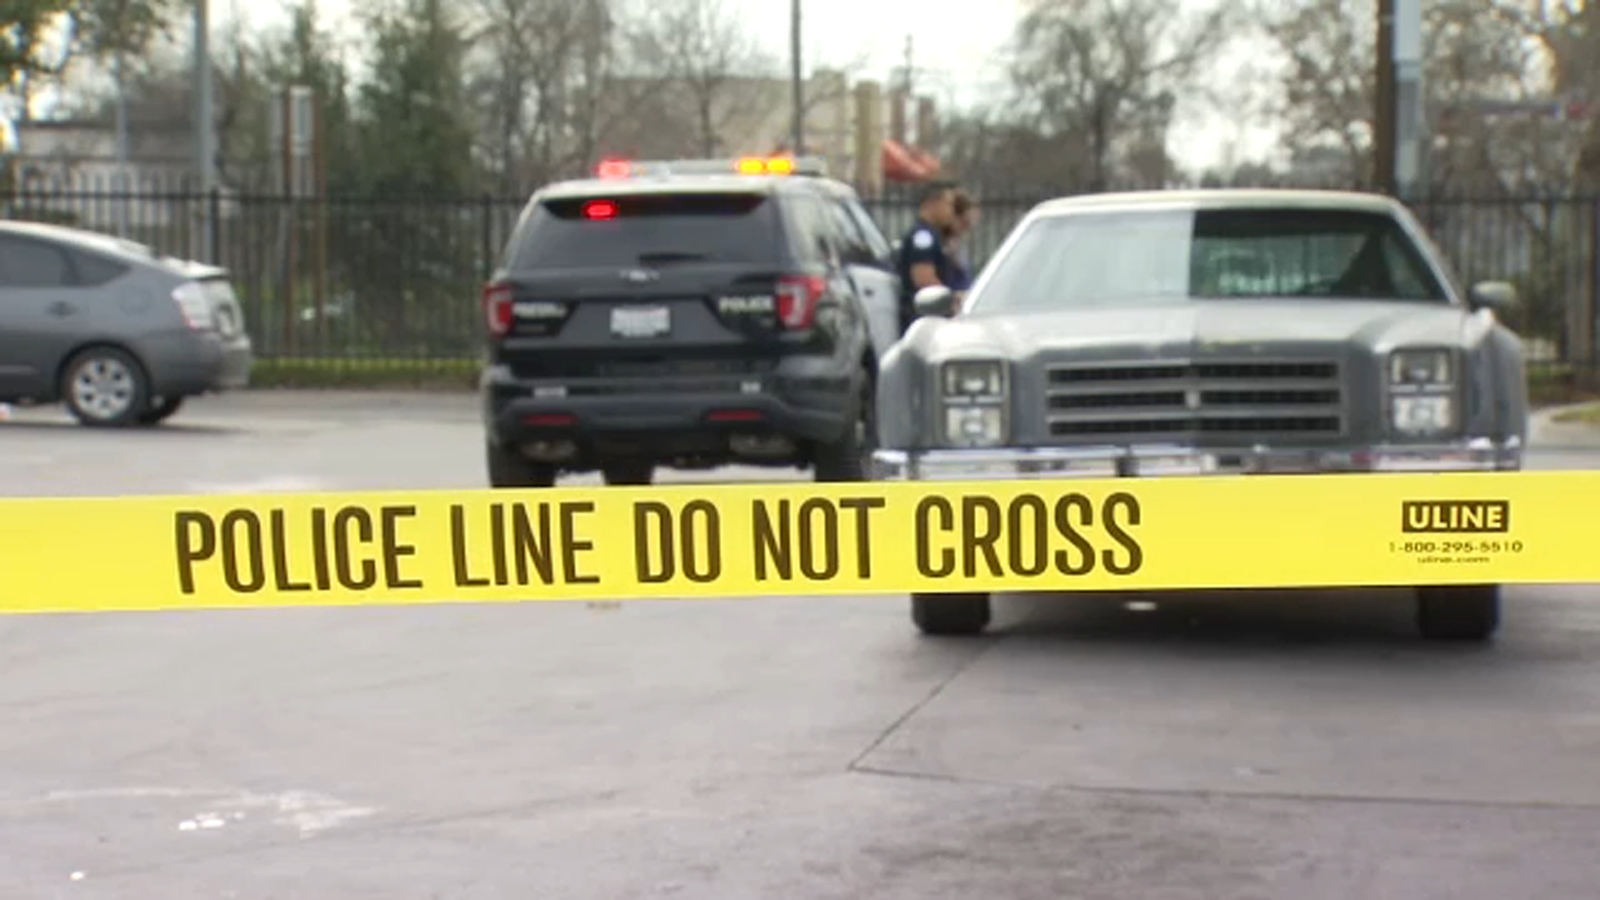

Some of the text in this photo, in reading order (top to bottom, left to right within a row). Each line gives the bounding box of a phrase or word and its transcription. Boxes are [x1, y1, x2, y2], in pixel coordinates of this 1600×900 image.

[1408, 505, 1503, 529] ULINE
[176, 492, 1143, 594] POLICE LINE DO NOT CROSS
[1389, 541, 1524, 553] 1-800-295-5510
[1417, 555, 1490, 564] uline.com
